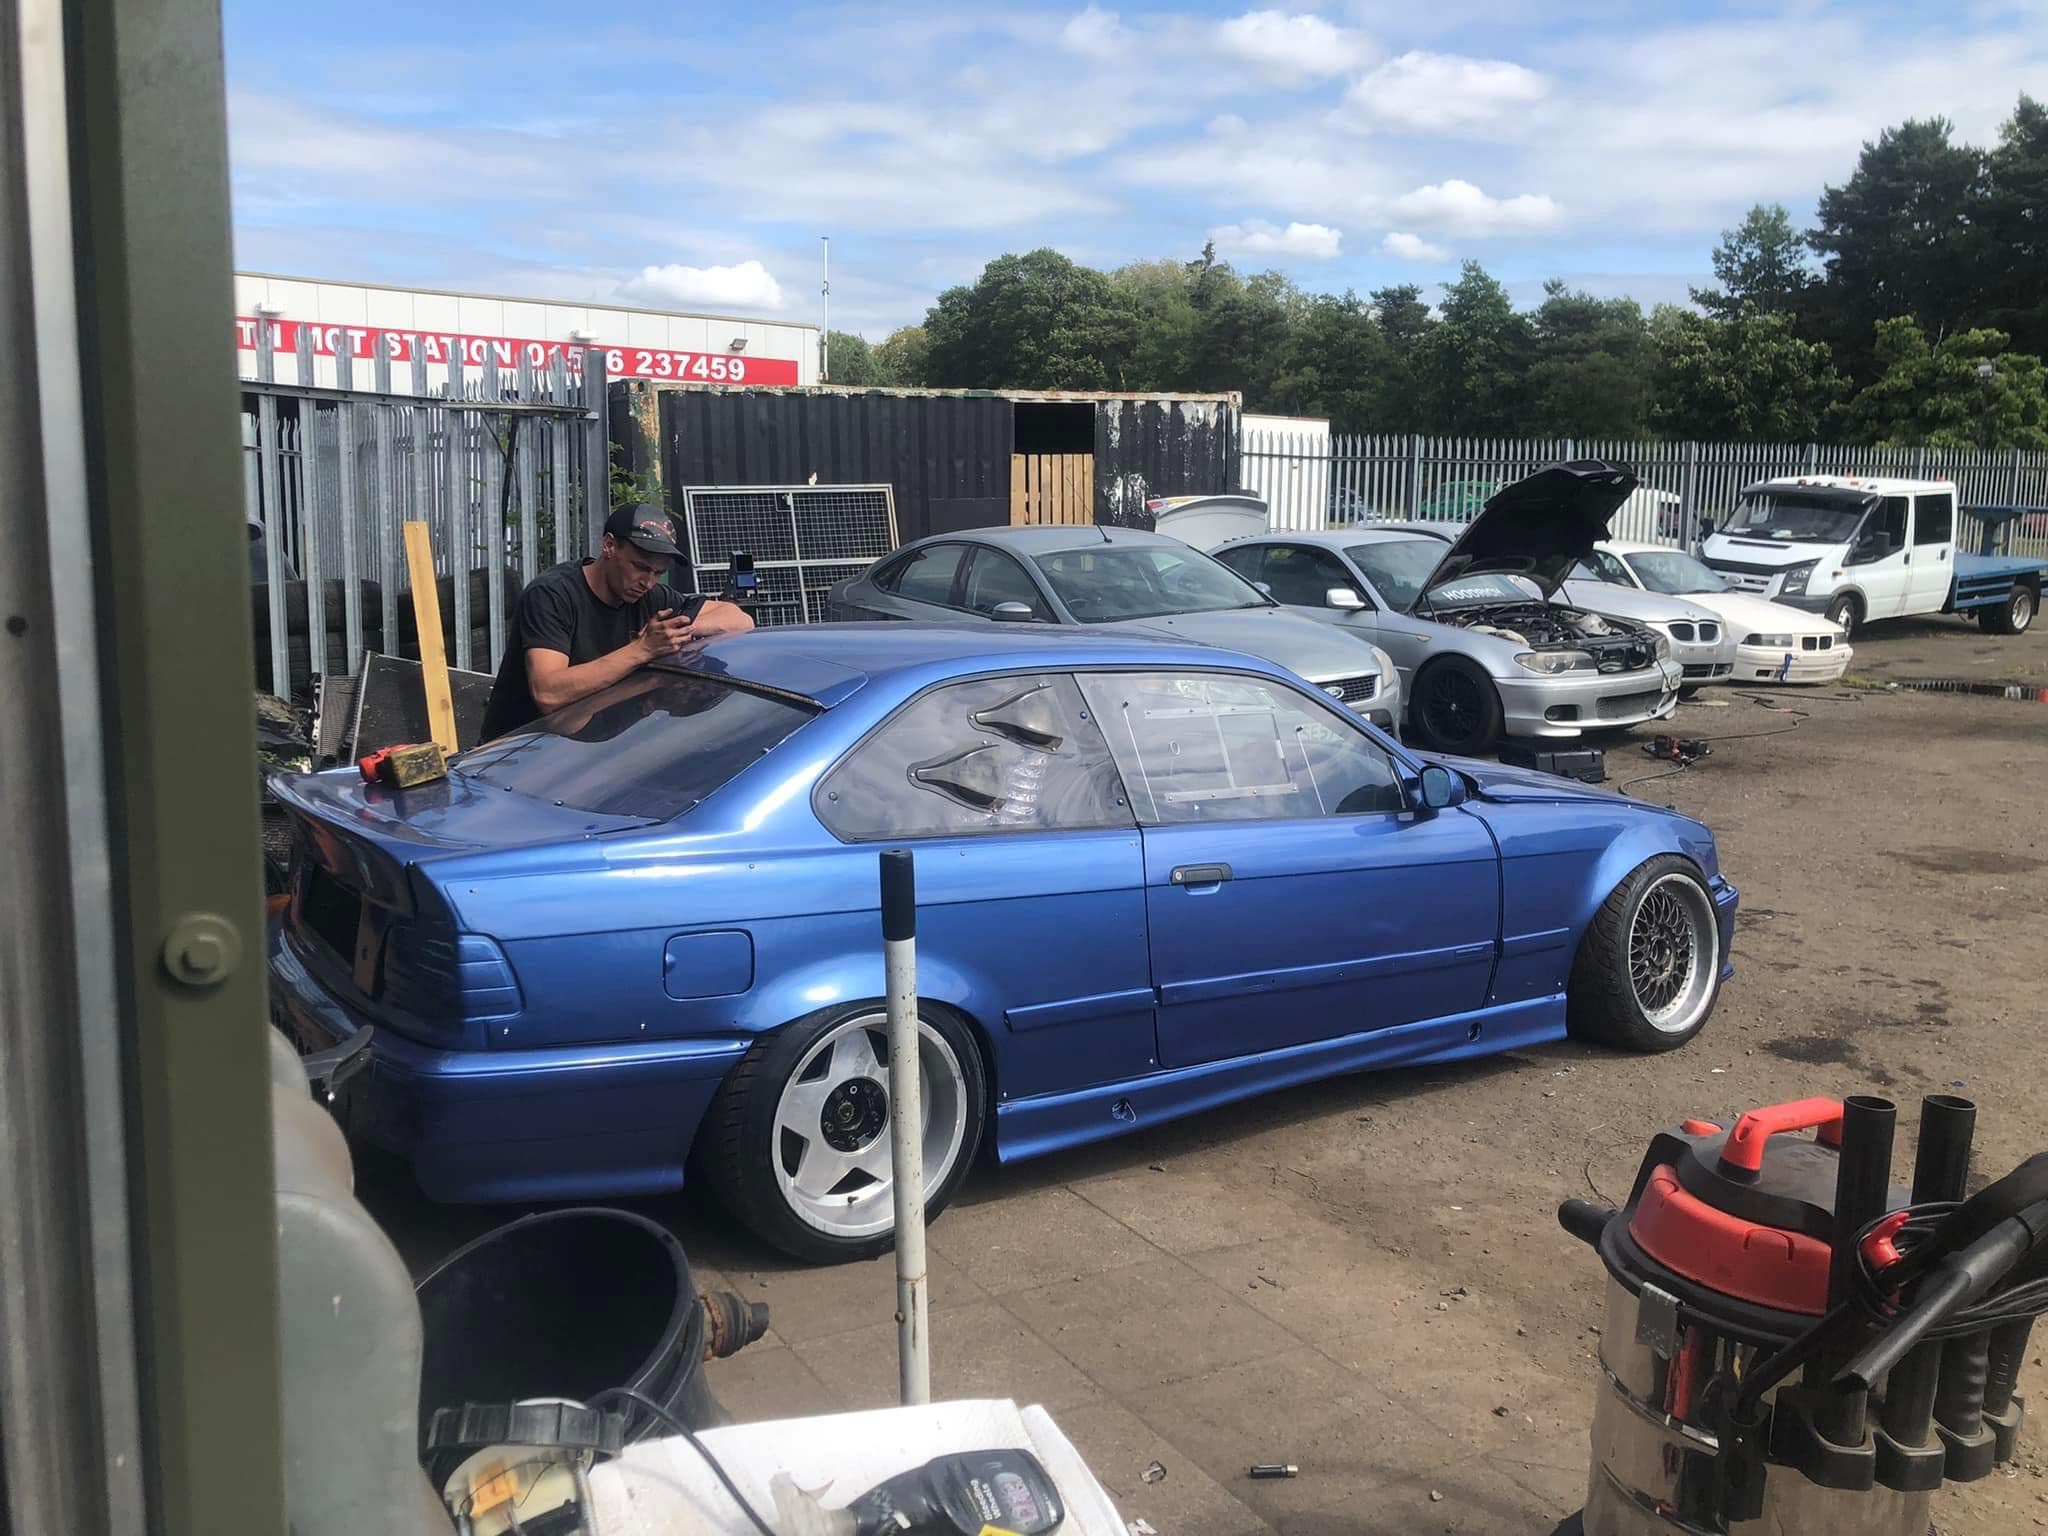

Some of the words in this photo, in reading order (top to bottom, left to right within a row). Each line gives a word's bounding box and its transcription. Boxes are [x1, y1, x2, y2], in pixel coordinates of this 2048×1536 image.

[384, 332, 512, 365] STATION
[527, 342, 624, 374] 056
[635, 350, 745, 382] 237459
